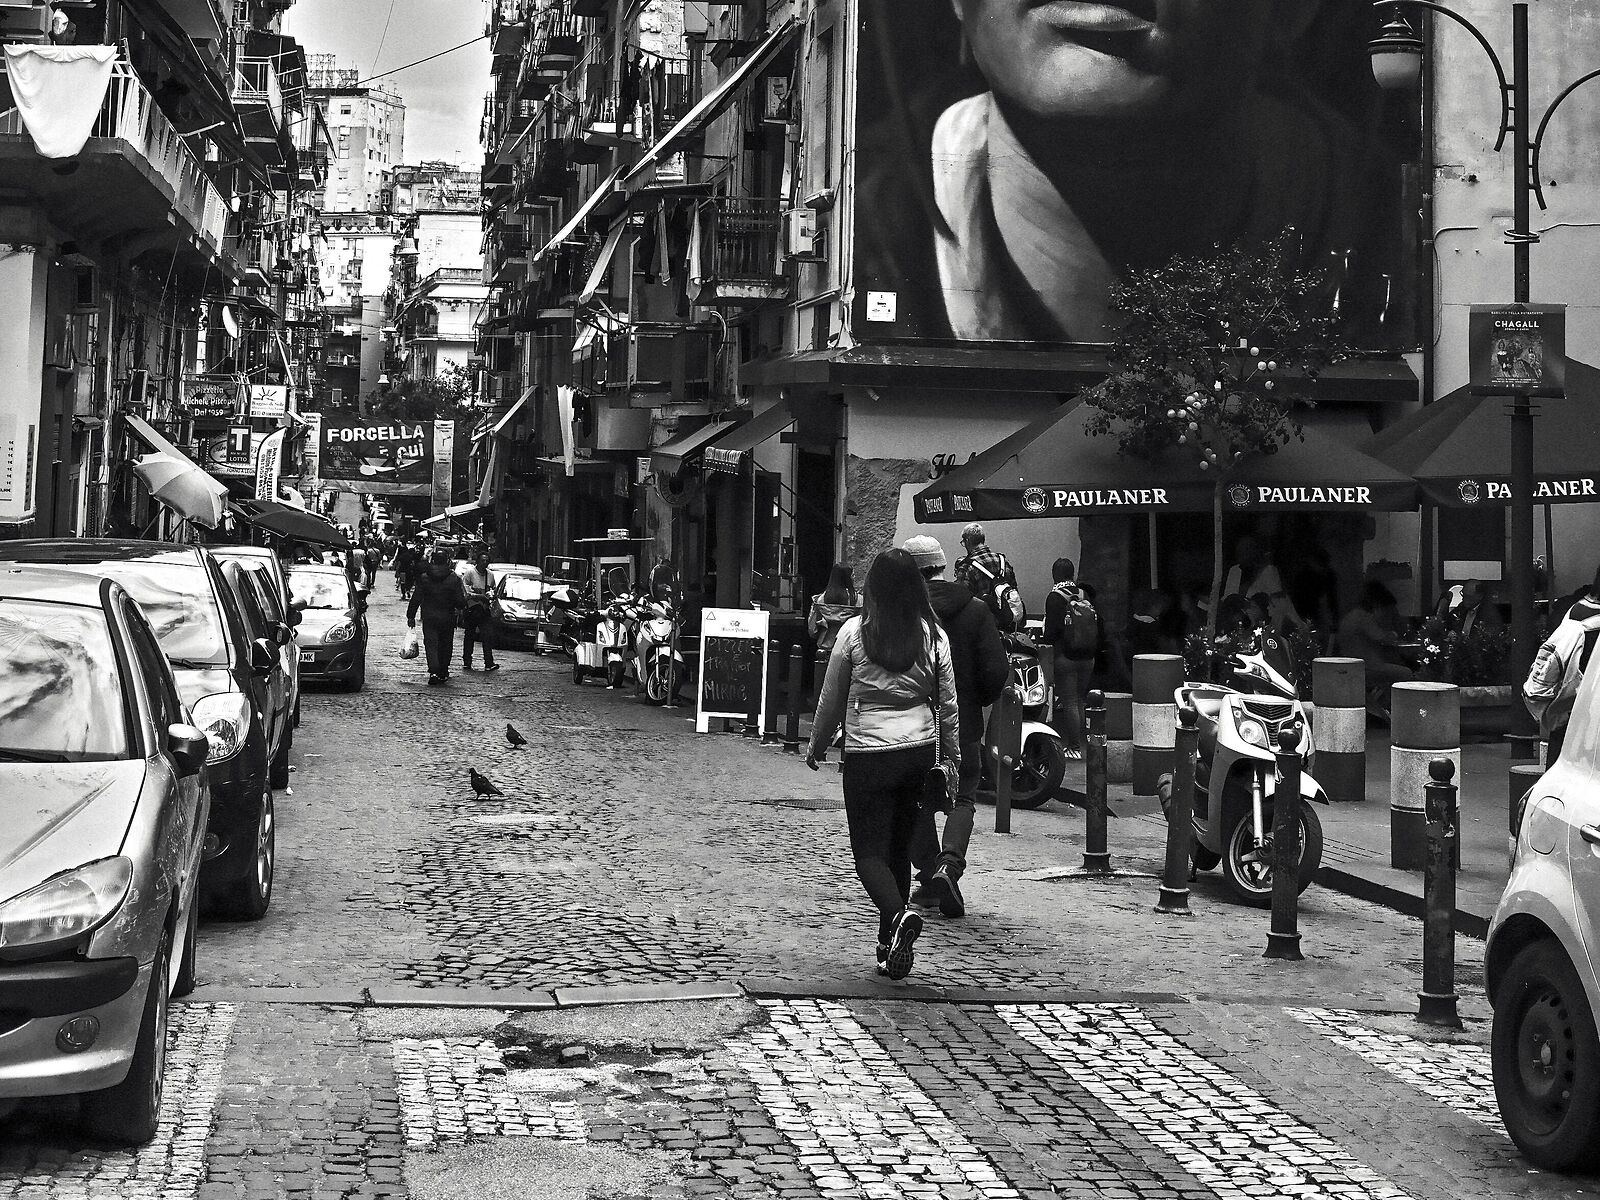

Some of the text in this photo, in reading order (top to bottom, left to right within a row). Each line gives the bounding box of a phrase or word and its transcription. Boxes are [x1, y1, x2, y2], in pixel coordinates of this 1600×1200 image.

[1494, 320, 1540, 328] CHAGALL
[183, 397, 209, 405] Michele
[194, 408, 224, 416] Dal 1959
[230, 428, 249, 451] T
[327, 424, 425, 443] FORCELLA
[1257, 486, 1372, 504] PAULANER
[1486, 478, 1597, 499] PAANER
[1052, 488, 1169, 508] PAULANER
